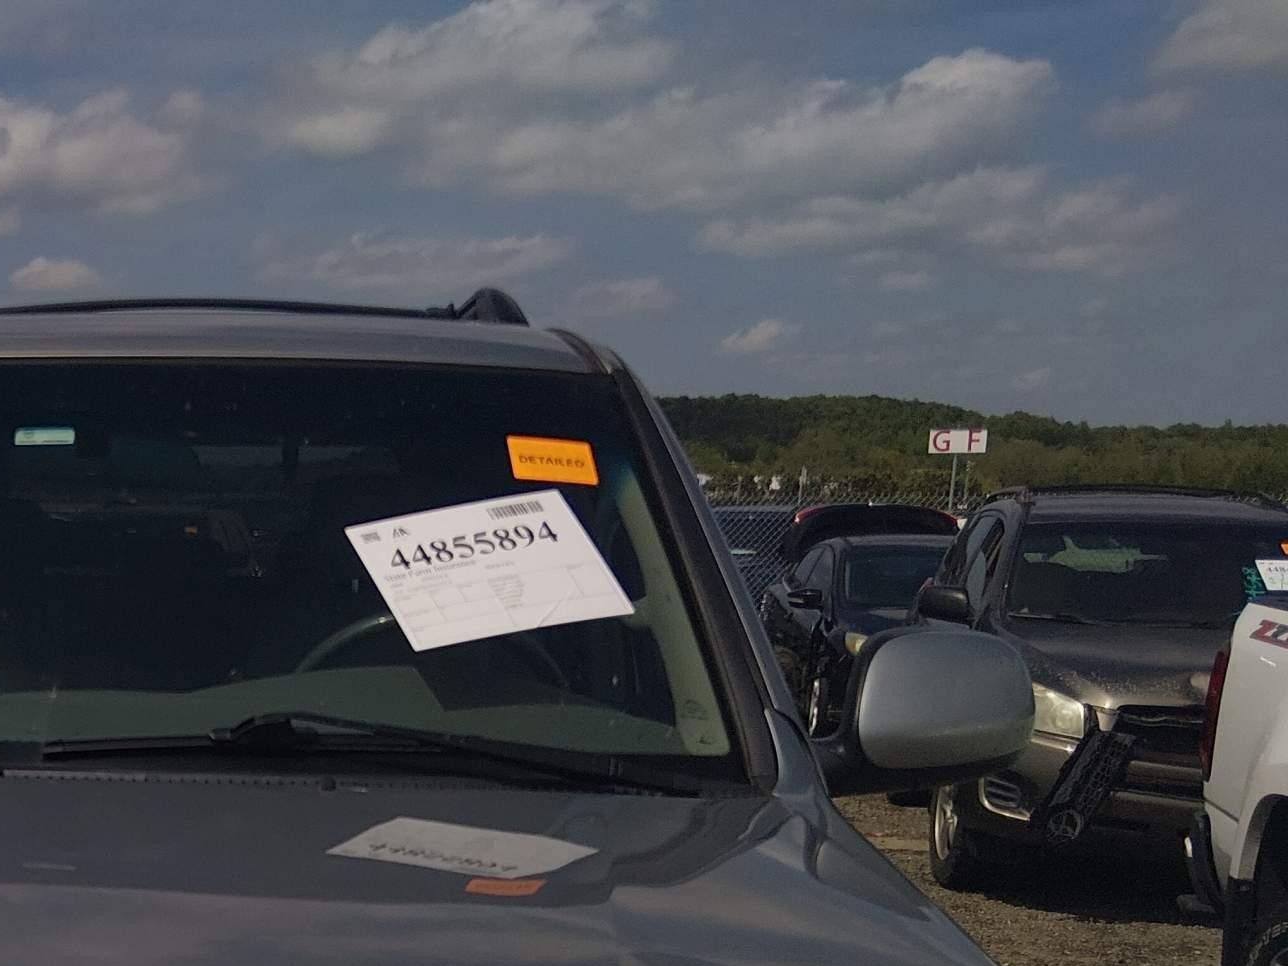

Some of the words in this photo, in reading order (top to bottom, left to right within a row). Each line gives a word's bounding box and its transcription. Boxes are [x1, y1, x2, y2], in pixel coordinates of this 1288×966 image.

[933, 429, 951, 452] G
[967, 428, 983, 452] F
[517, 455, 586, 469] DETAILED
[390, 520, 559, 570] 44855894
